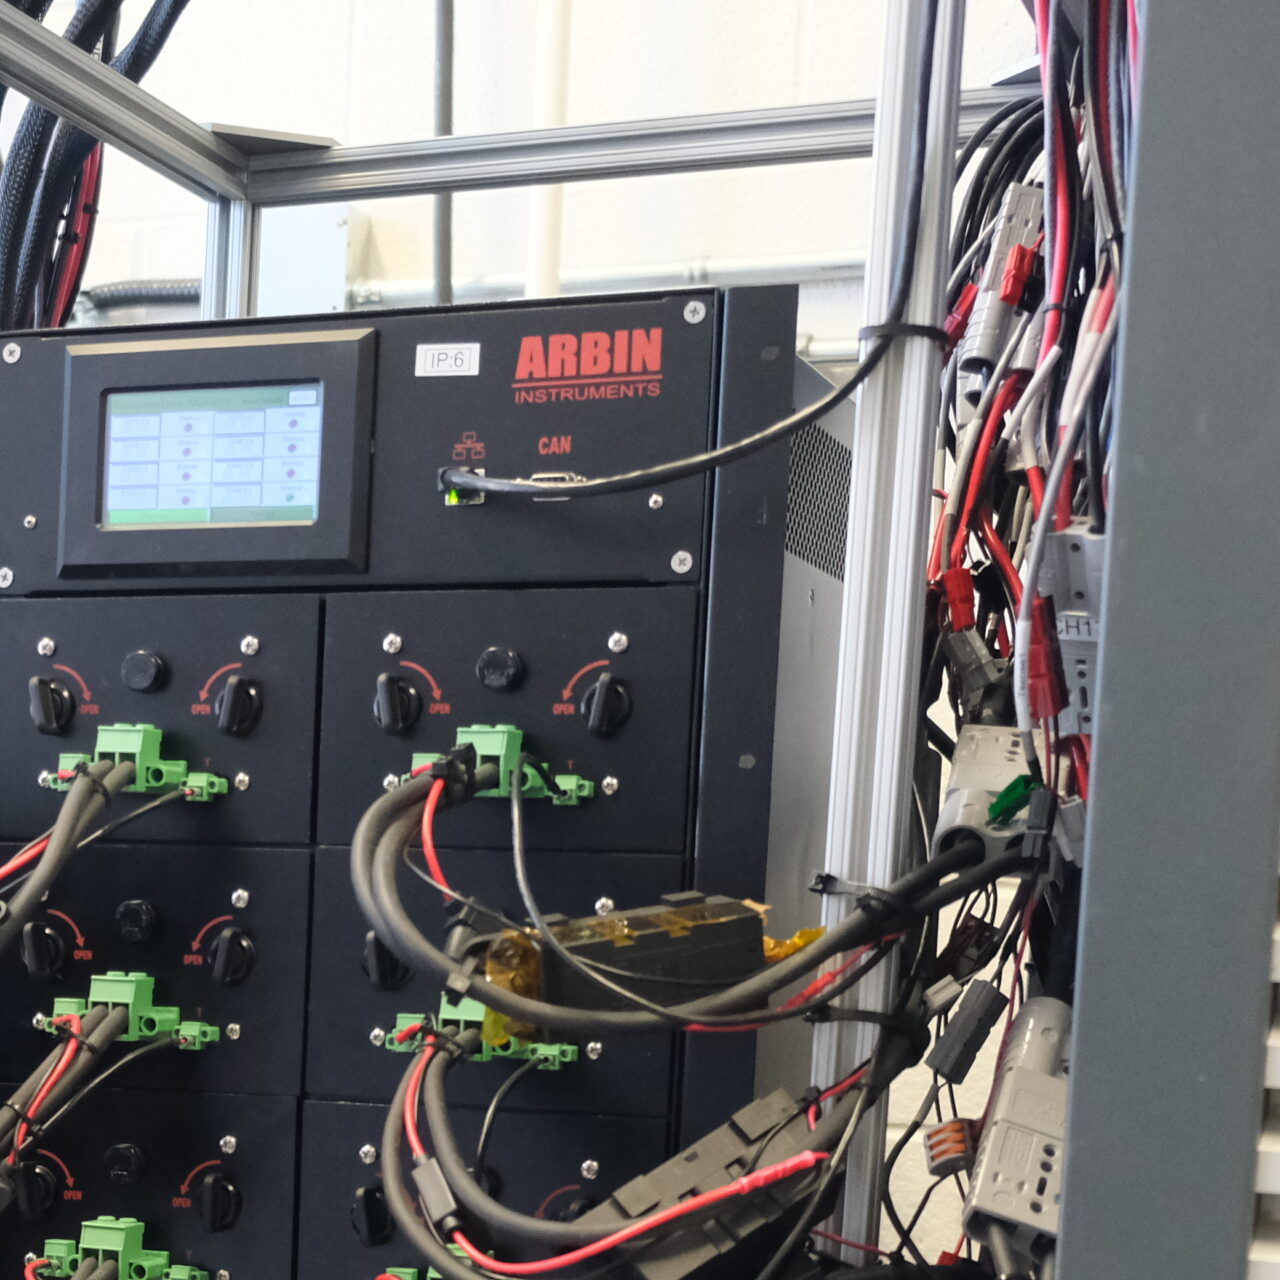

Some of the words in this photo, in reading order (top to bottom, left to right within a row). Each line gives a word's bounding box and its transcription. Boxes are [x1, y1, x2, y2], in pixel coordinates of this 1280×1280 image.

[515, 328, 663, 380] ARBIN
[431, 352, 465, 369] IP:6
[515, 381, 662, 404] INSTRUMENTS
[538, 436, 572, 454] CAN
[191, 704, 211, 715] OPEN
[429, 703, 450, 714] OPEN
[552, 703, 575, 715] OPEN
[74, 950, 92, 960] OPEN
[184, 954, 202, 965] OPEN
[64, 1190, 82, 1200] OPEN
[172, 1197, 192, 1208] OPEN
